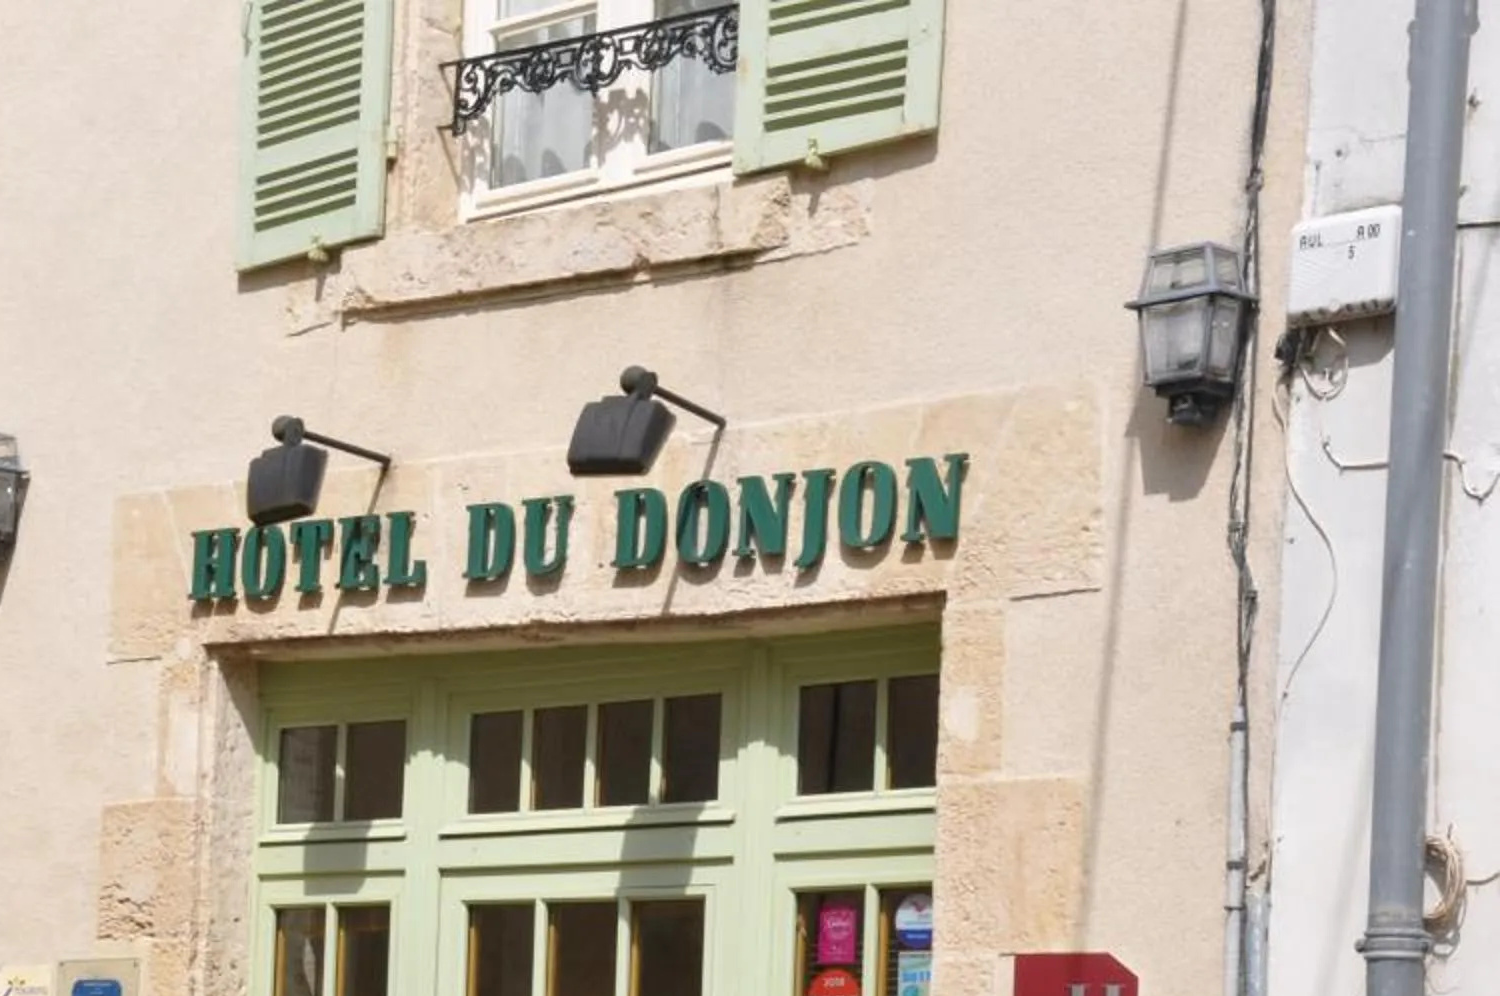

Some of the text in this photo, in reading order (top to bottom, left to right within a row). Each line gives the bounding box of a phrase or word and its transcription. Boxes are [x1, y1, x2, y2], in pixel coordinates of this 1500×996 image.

[188, 453, 970, 601] HOTEL DU DONJON
